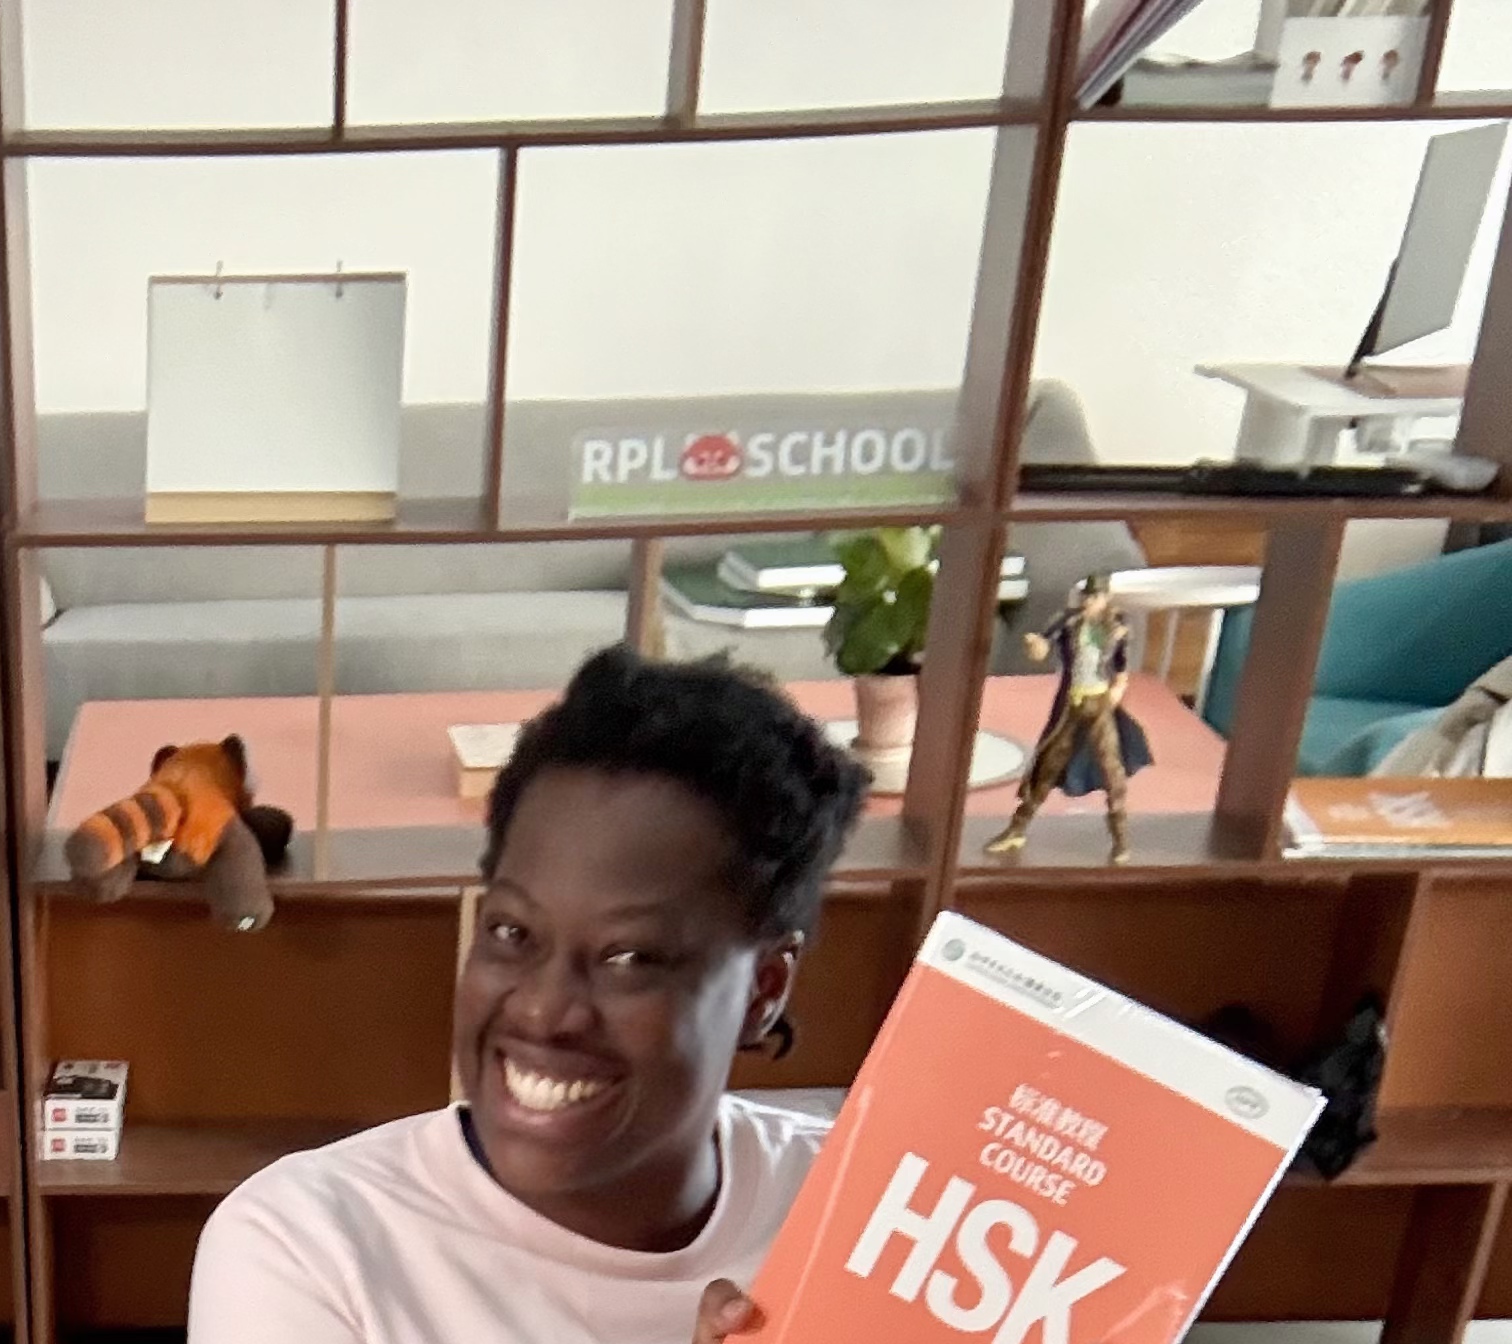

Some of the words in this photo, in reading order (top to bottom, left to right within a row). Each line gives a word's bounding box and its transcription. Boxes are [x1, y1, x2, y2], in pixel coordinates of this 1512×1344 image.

[581, 435, 679, 483] RPL
[744, 427, 955, 477] SCHOOL
[977, 1106, 1108, 1186] STANDARD
[979, 1142, 1077, 1206] COURSE
